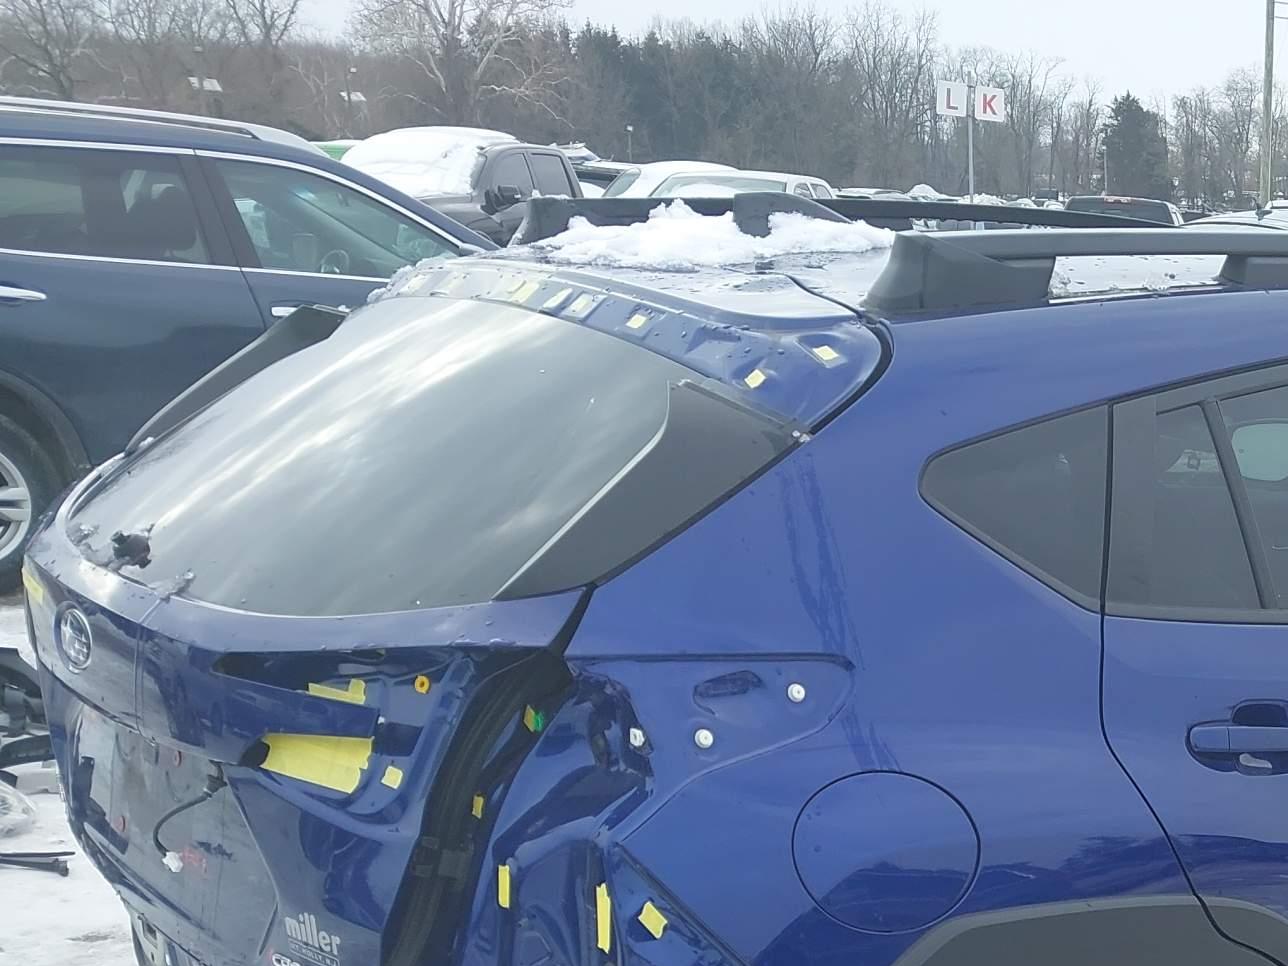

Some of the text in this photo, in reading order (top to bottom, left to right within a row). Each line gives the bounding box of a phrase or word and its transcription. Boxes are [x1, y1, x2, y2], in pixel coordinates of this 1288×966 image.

[946, 88, 959, 110] L
[982, 93, 998, 115] K
[284, 912, 341, 955] miller
